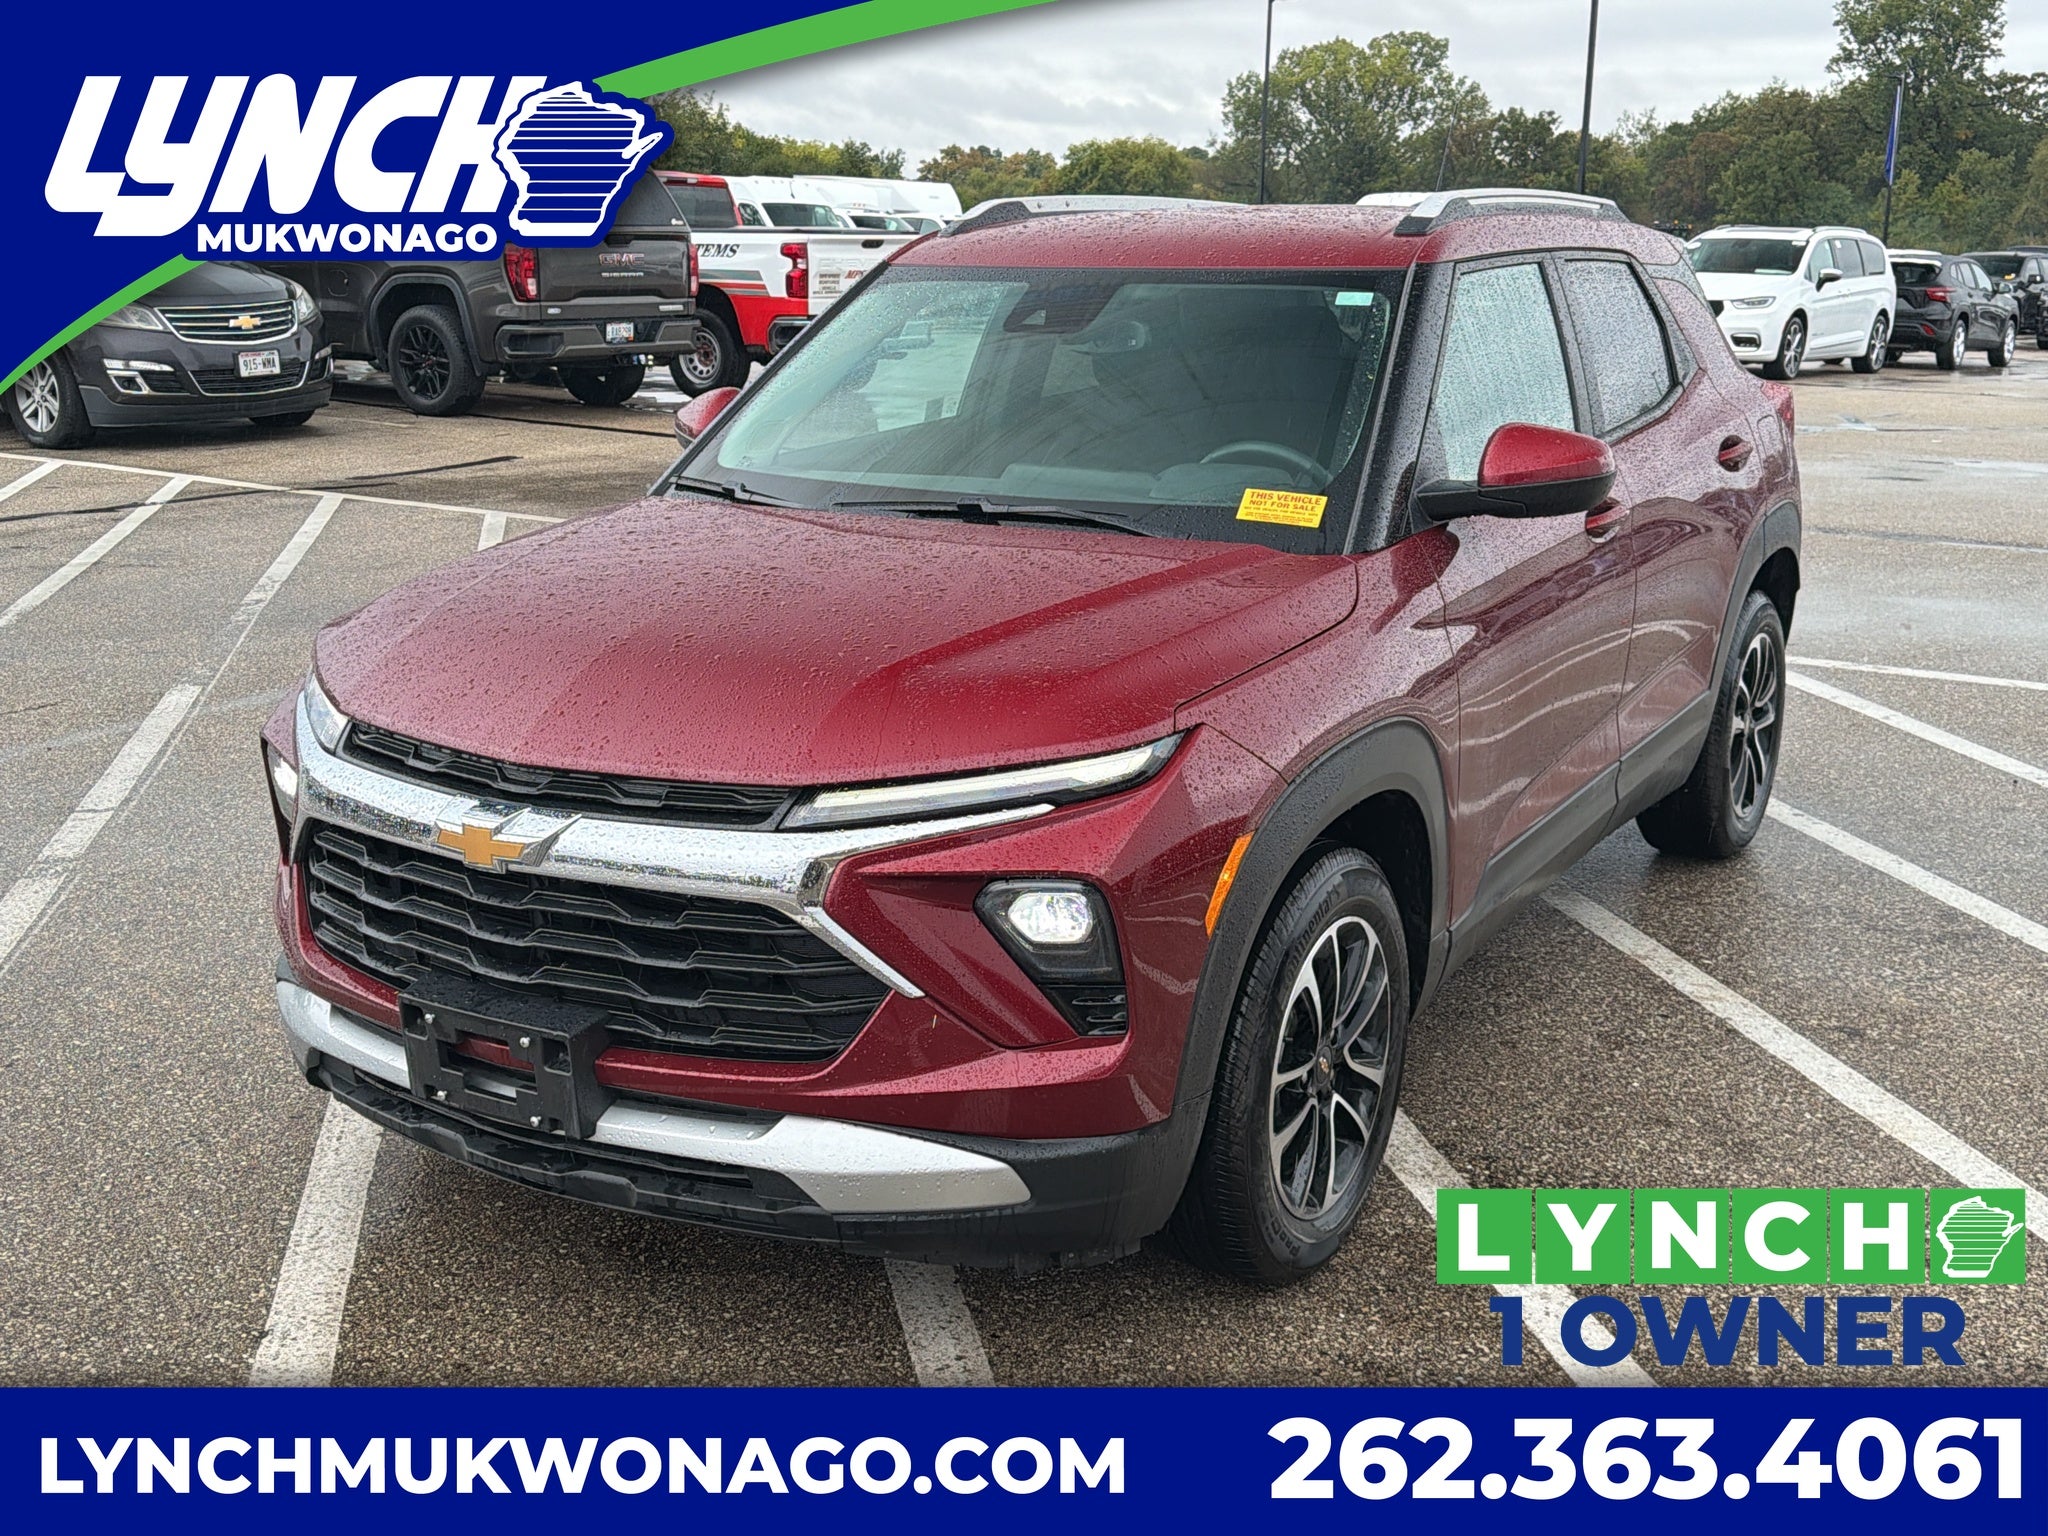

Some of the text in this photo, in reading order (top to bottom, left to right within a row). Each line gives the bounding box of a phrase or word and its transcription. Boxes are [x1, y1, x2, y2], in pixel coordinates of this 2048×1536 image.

[599, 253, 645, 266] GMC
[1250, 491, 1323, 506] THIS VEHICLE
[1270, 501, 1291, 509] FOR
[1293, 504, 1317, 512] SALE
